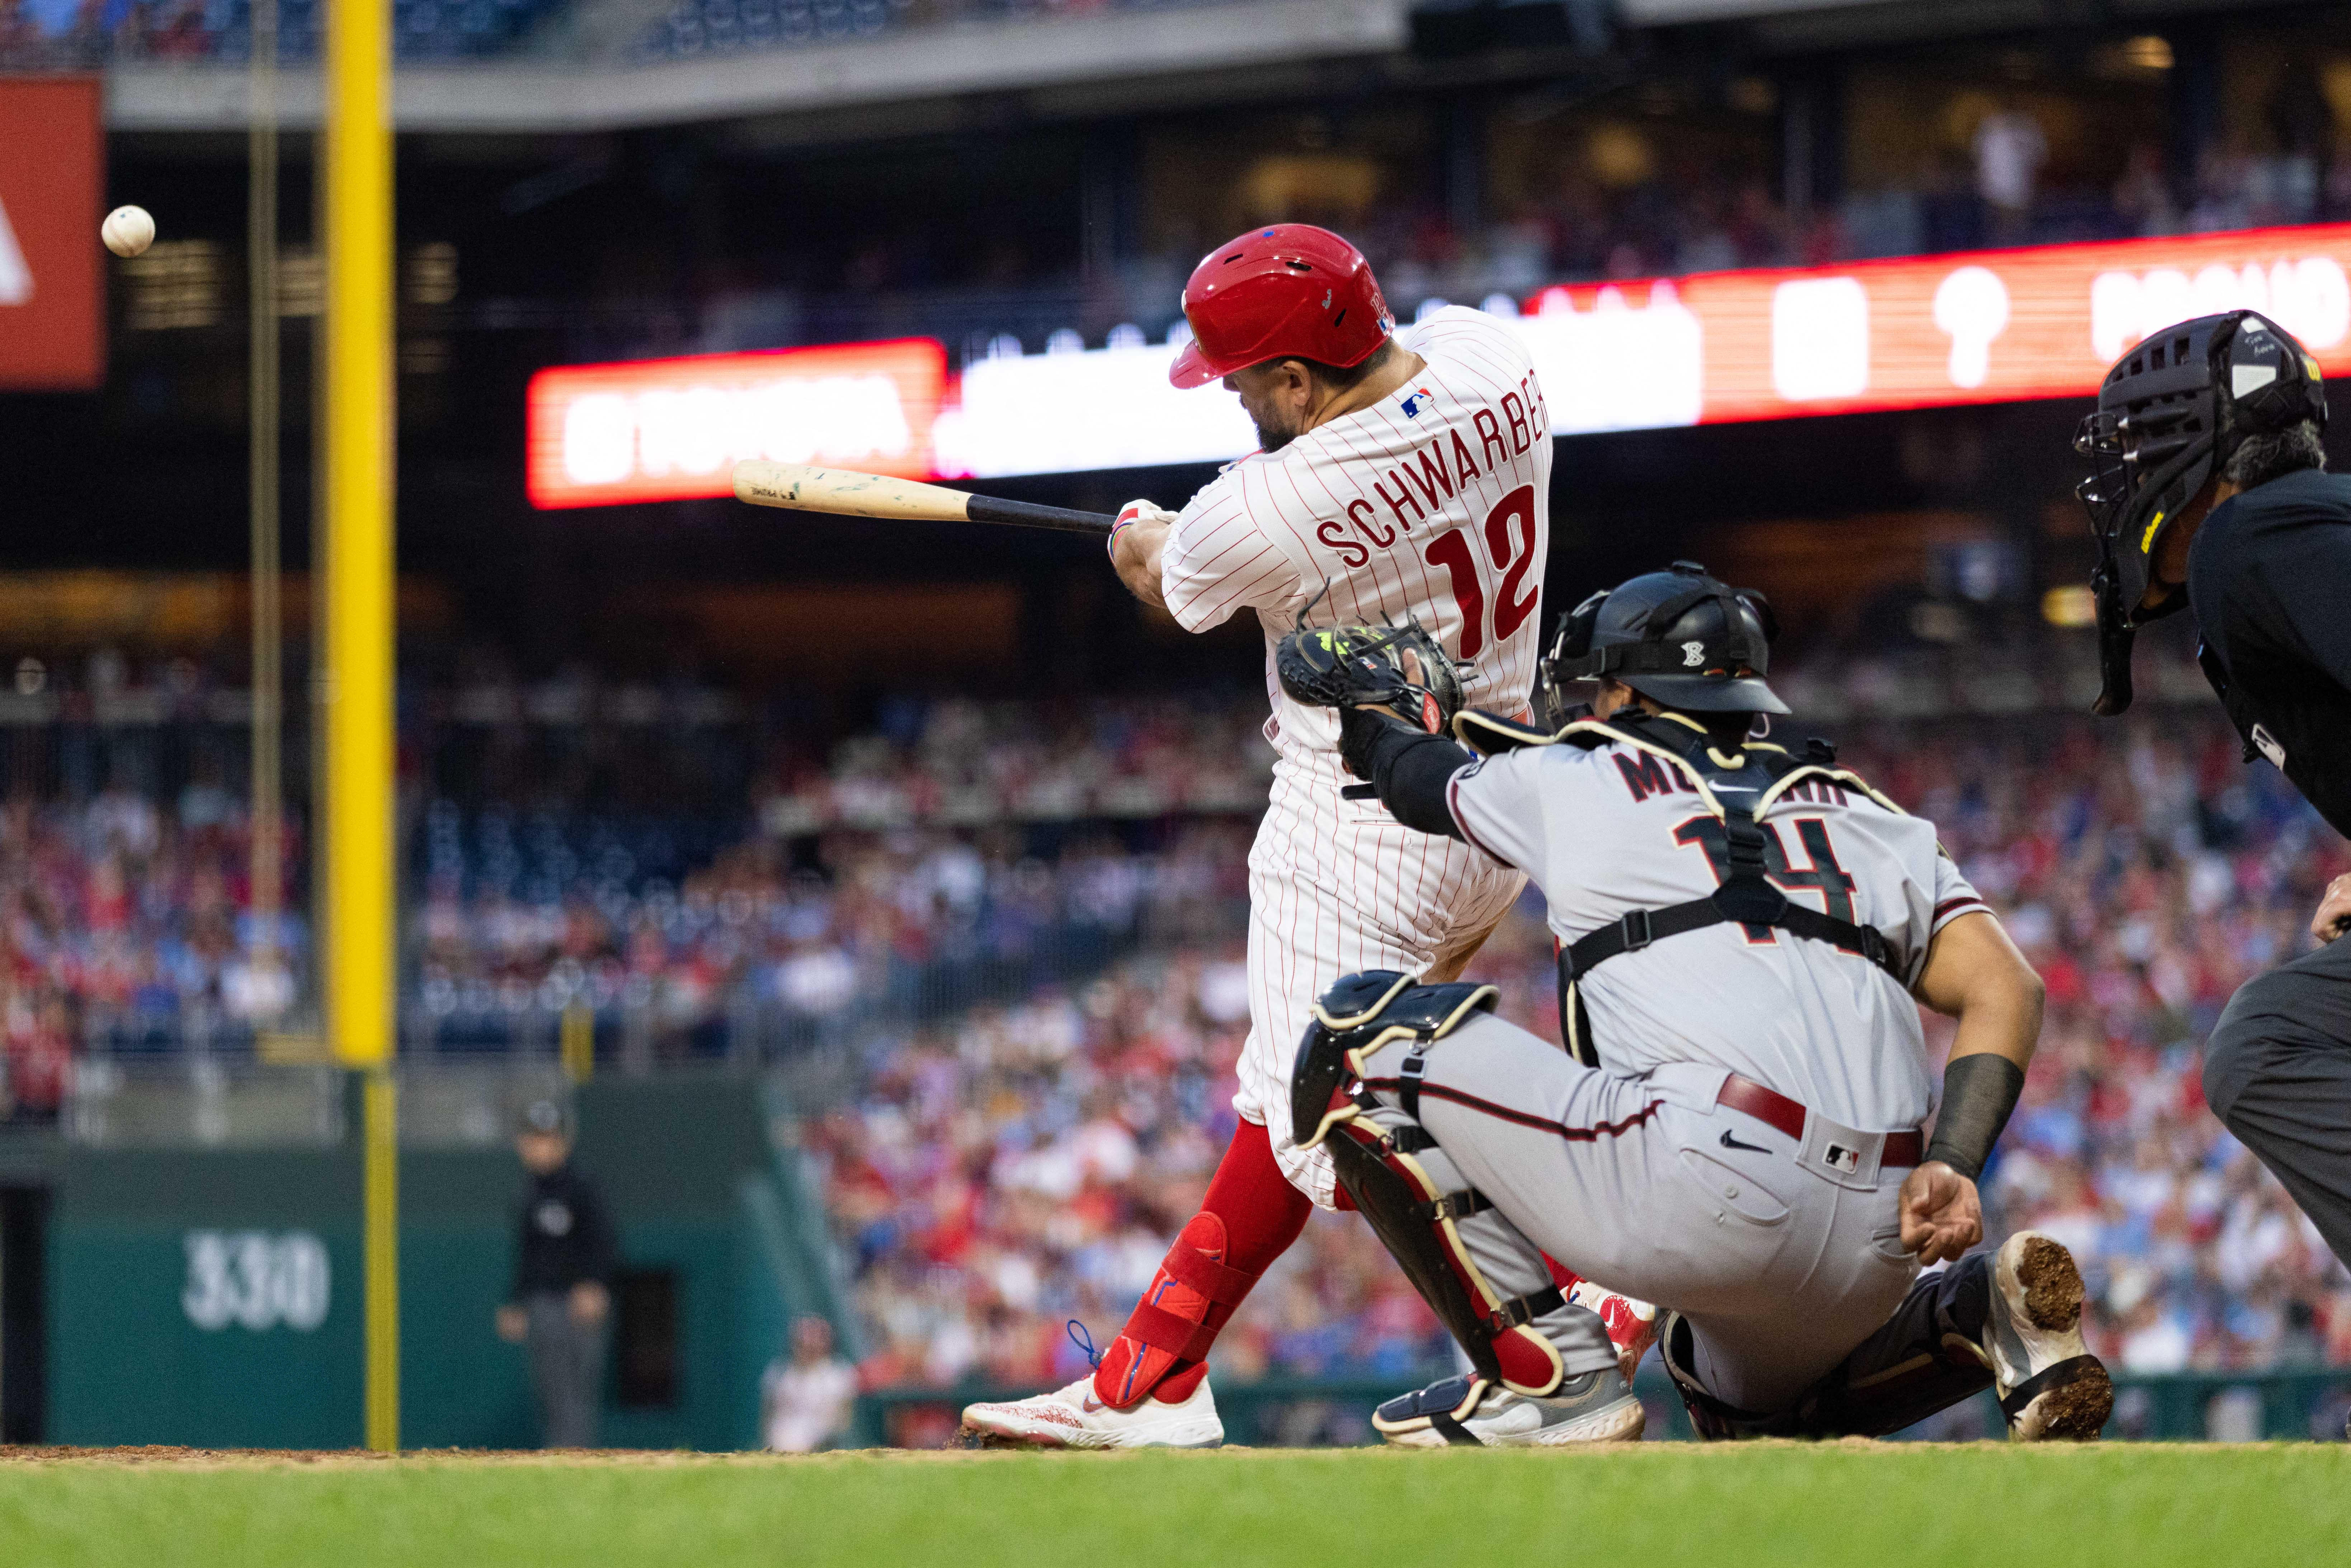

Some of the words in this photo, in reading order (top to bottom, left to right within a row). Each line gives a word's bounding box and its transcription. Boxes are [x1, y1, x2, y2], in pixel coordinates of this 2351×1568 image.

[1425, 483, 1538, 659] 12
[1667, 811, 1867, 958] 14
[183, 1231, 329, 1330] 330
